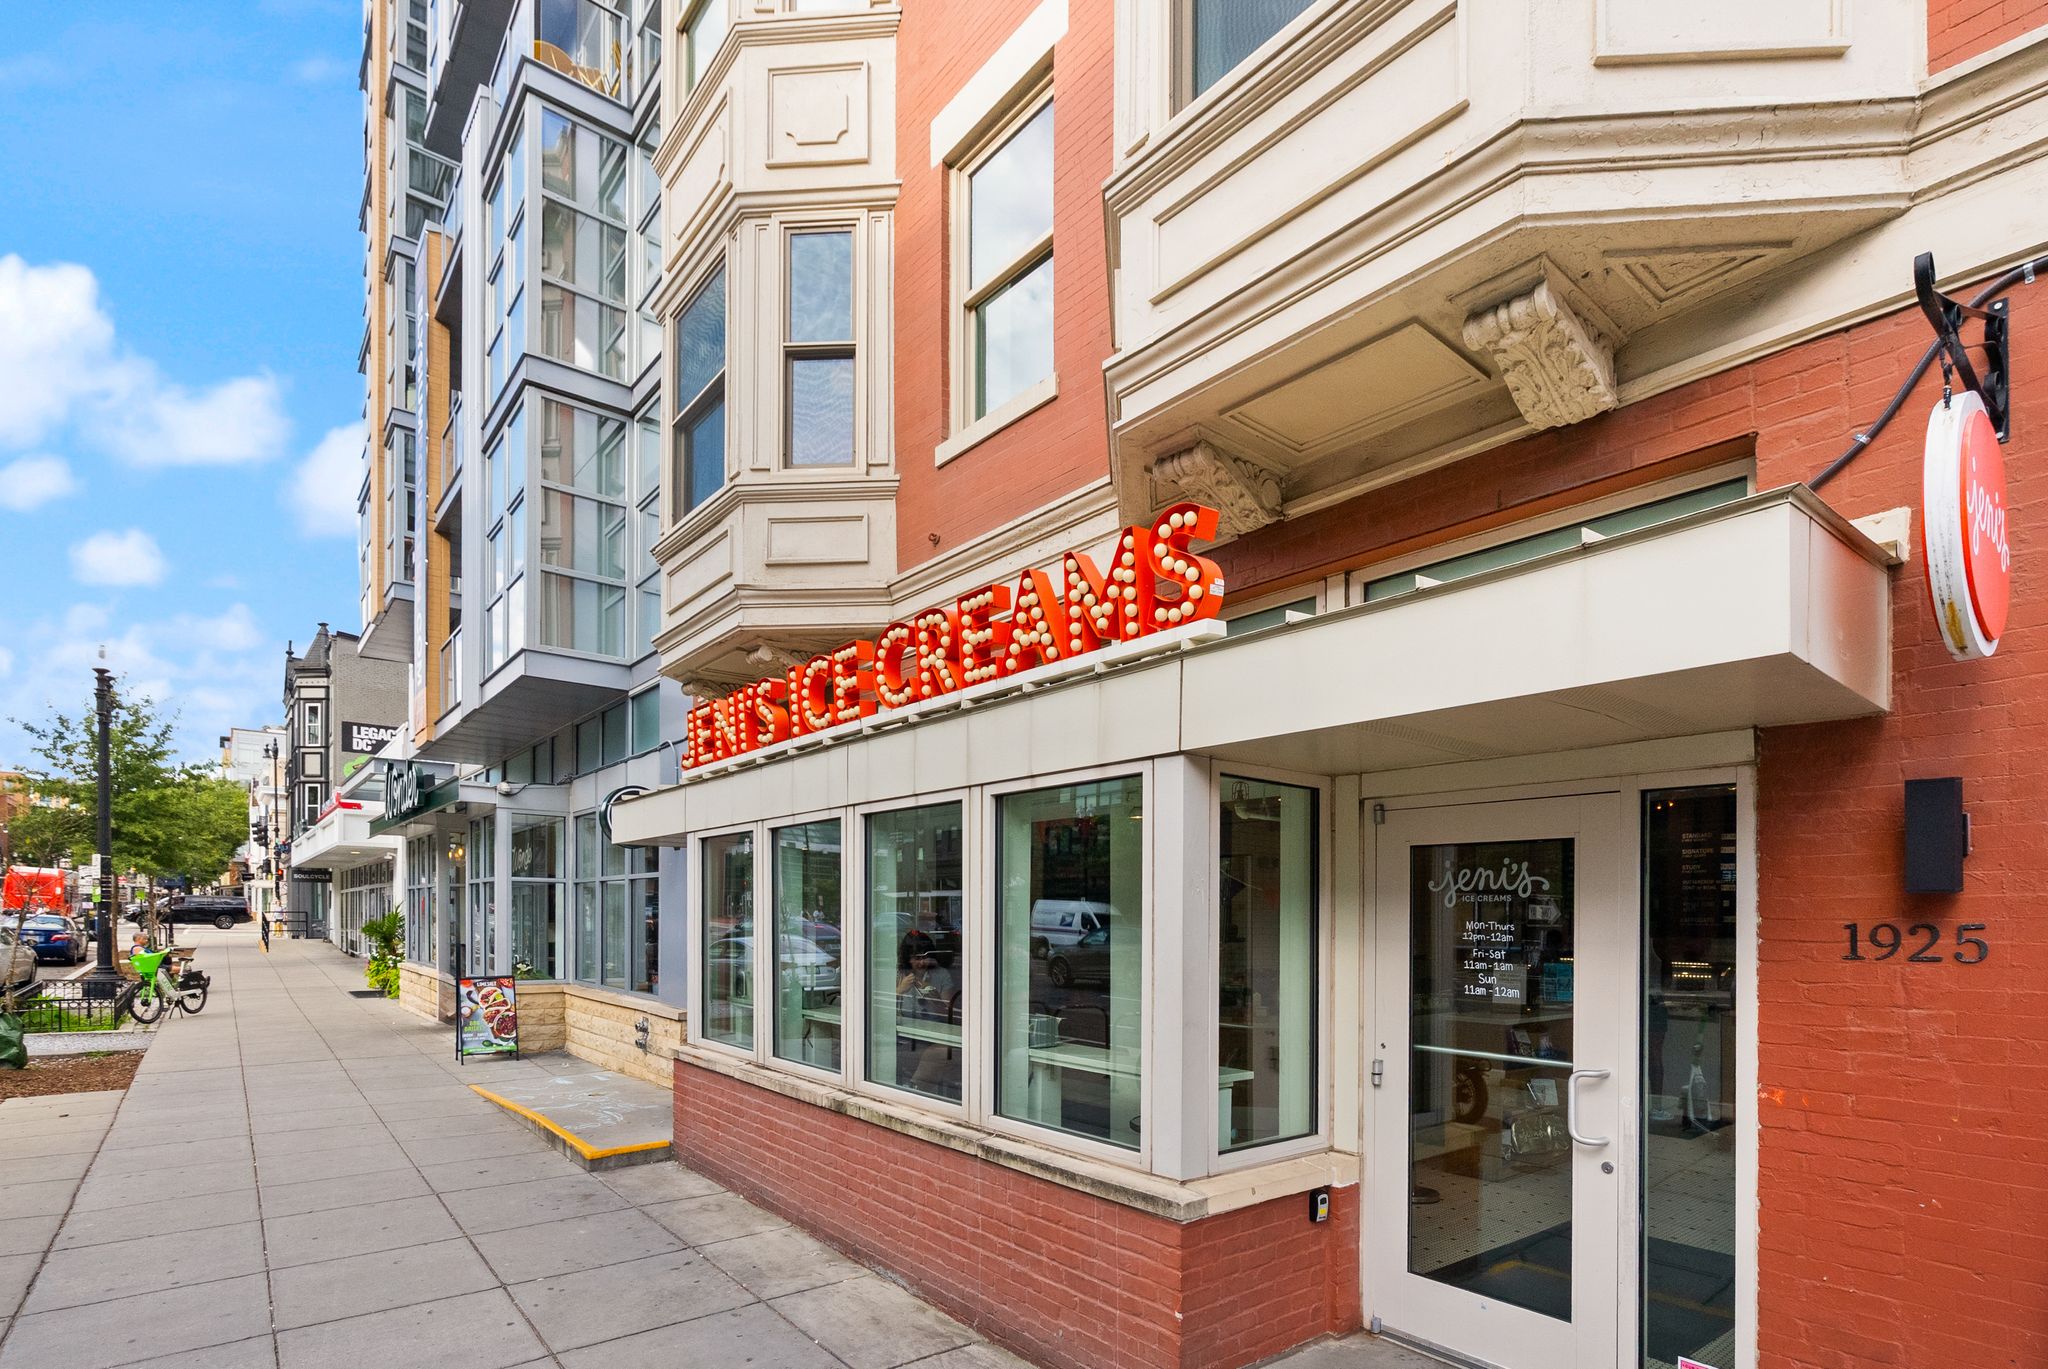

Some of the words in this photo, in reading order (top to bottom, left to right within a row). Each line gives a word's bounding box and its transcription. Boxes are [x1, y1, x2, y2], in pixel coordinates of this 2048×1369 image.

[682, 677, 789, 770] JENI'S
[787, 640, 876, 738] ICE
[873, 502, 1223, 709] CREAMS
[352, 725, 398, 741] LEGAC
[1428, 857, 1550, 908] jeni's
[1462, 894, 1475, 902] ICE
[1477, 894, 1512, 902] CREAMS
[1465, 921, 1515, 932] Mon-Thurs
[1842, 923, 1988, 963] 1925
[1472, 949, 1506, 959] Fri-Sat
[1478, 973, 1497, 985] Sun
